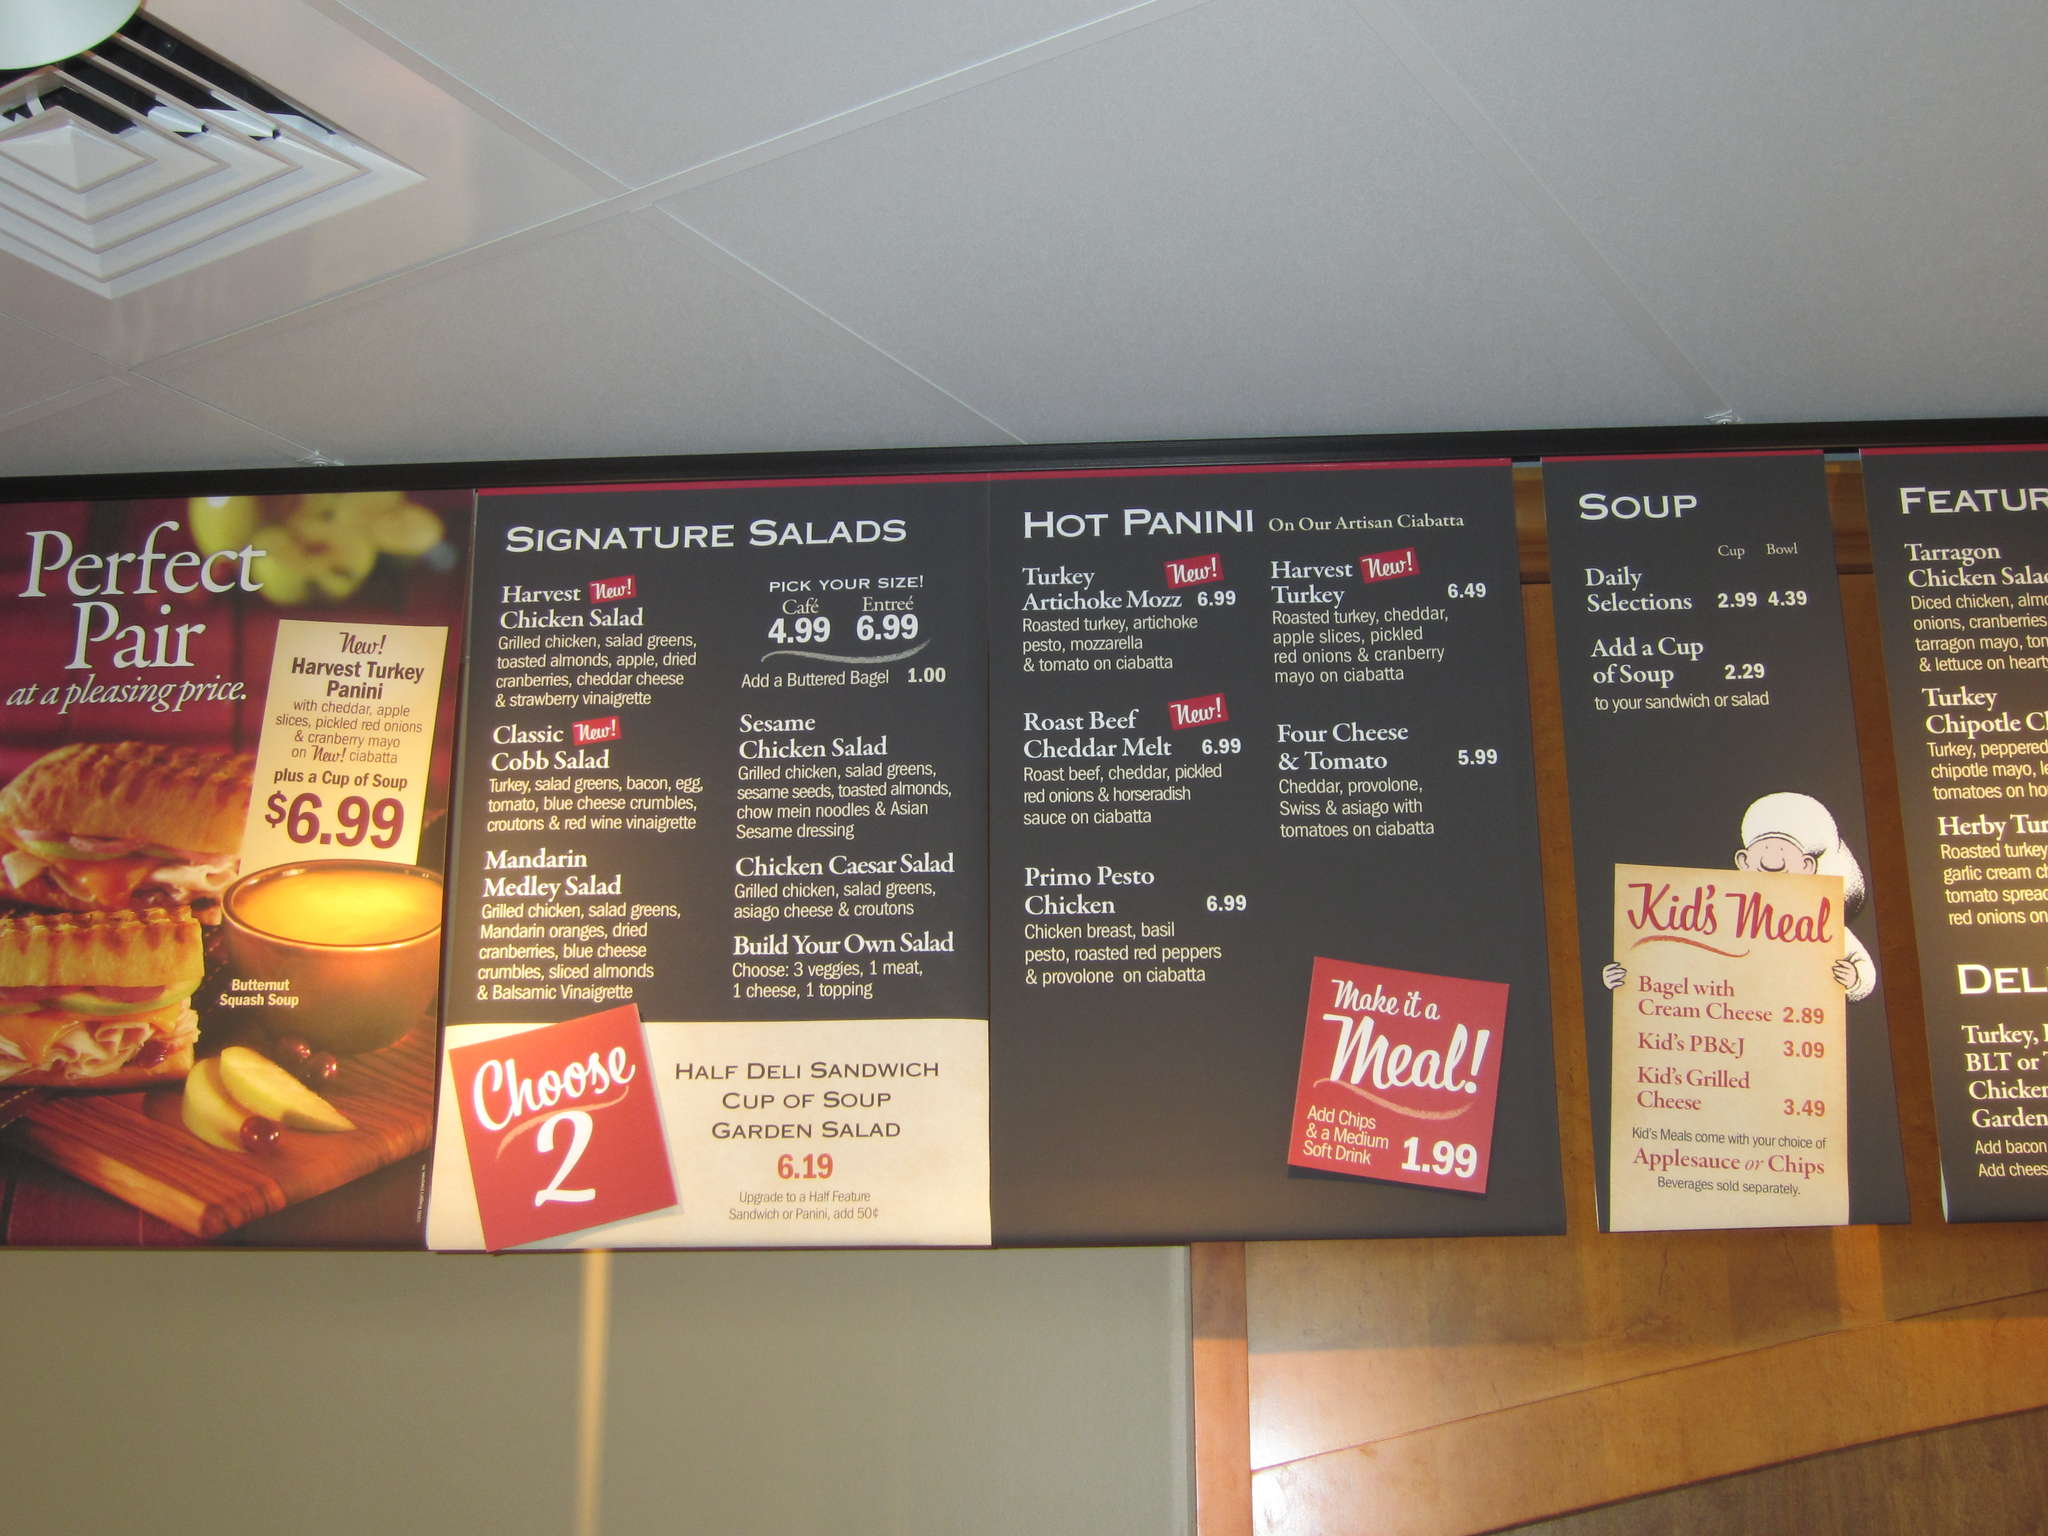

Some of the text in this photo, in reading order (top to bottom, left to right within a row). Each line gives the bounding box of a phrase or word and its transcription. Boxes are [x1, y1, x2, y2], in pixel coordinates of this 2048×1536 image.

[1579, 494, 1697, 520] SOUP
[1024, 509, 1253, 538] HOT PANINI
[1269, 513, 1464, 531] On Our Artisan Ciabatta
[506, 519, 907, 552] SIGNATURE SALADS
[19, 521, 266, 597] Perfect
[1718, 543, 1798, 559] Cup Bowl
[1904, 543, 2001, 566] Tarragon
[1022, 557, 1217, 590] Turkey New!
[1271, 552, 1412, 579] Harvest New!
[769, 575, 924, 592] PICK YOUR SIZE!
[1584, 566, 1642, 591] Daily
[1908, 568, 1997, 587] Chicken
[502, 578, 632, 603] Harvest New!
[1022, 590, 1236, 610] Artichoke Mozz 6.99
[1271, 583, 1486, 608] Turkey 6.49
[1587, 591, 1807, 612] Selections 2.99 4.39
[1911, 594, 2013, 609] Diced chicken,
[783, 598, 819, 614] Café
[500, 607, 643, 629] Chicken Salad
[768, 614, 918, 643] 4.99 6.99
[65, 601, 206, 669] Pair
[339, 632, 385, 655] New!
[498, 633, 696, 649] Grilled chicken, salad greens,
[1591, 637, 1703, 661] Add a Cup
[292, 658, 424, 684] Harvest Turkey
[741, 667, 946, 688] Add a Buttered Bagel 1.00
[1593, 663, 1765, 688] of Soup 2.29
[6, 673, 246, 714] at a pleasing price.
[327, 681, 382, 699] Panini
[294, 700, 410, 718] with cheddar, apple
[1595, 691, 1769, 713] to your sandwich or salad
[276, 714, 422, 733] slices, pickled red onions
[294, 730, 400, 749] & cranberry mayo
[291, 745, 397, 764] on New! ciabatta
[274, 768, 407, 790] plus a Cup of Soup
[264, 790, 404, 849] $6.99
[1628, 883, 1833, 943] Kid's Meal
[733, 931, 954, 956] Build Your Own Salad
[232, 979, 290, 991] Butternut
[1638, 976, 1735, 999] Bagel with
[219, 994, 299, 1008] Squash Soup
[1331, 979, 1440, 1020] Make it a
[1638, 999, 1824, 1024] Cream Cheese 2.89
[1638, 1033, 1825, 1058] Kid's PB&J 3.09
[1962, 1024, 2038, 1048] Turkey,
[1322, 1012, 1490, 1093] Meal!
[1964, 1052, 2039, 1072] BLT or
[676, 1062, 939, 1080] HALF DELI SANDWICH
[473, 1046, 636, 1131] Choose
[723, 1091, 892, 1109] CUP OF SOUP
[1307, 1105, 1376, 1130] Add Chips
[712, 1121, 900, 1139] GARDEN SALAD
[1306, 1123, 1389, 1149] & a Medium
[1632, 1128, 1826, 1148] Kid's Meals come with your choice of
[534, 1112, 596, 1207] 2
[1303, 1140, 1372, 1164] Soft Drink
[1401, 1137, 1477, 1178] 1.99
[777, 1155, 833, 1179] 6.19
[1632, 1148, 1825, 1180] Applesauce or Chips
[739, 1191, 783, 1205] Upgrade
[786, 1192, 796, 1201] to
[810, 1191, 829, 1201] Half
[833, 1191, 871, 1201] Feature
[1658, 1177, 1800, 1196] Beverages sold separately.
[729, 1208, 781, 1220] Sandwich
[783, 1210, 792, 1219] or
[796, 1208, 830, 1221] Panini,
[834, 1208, 853, 1219] add
